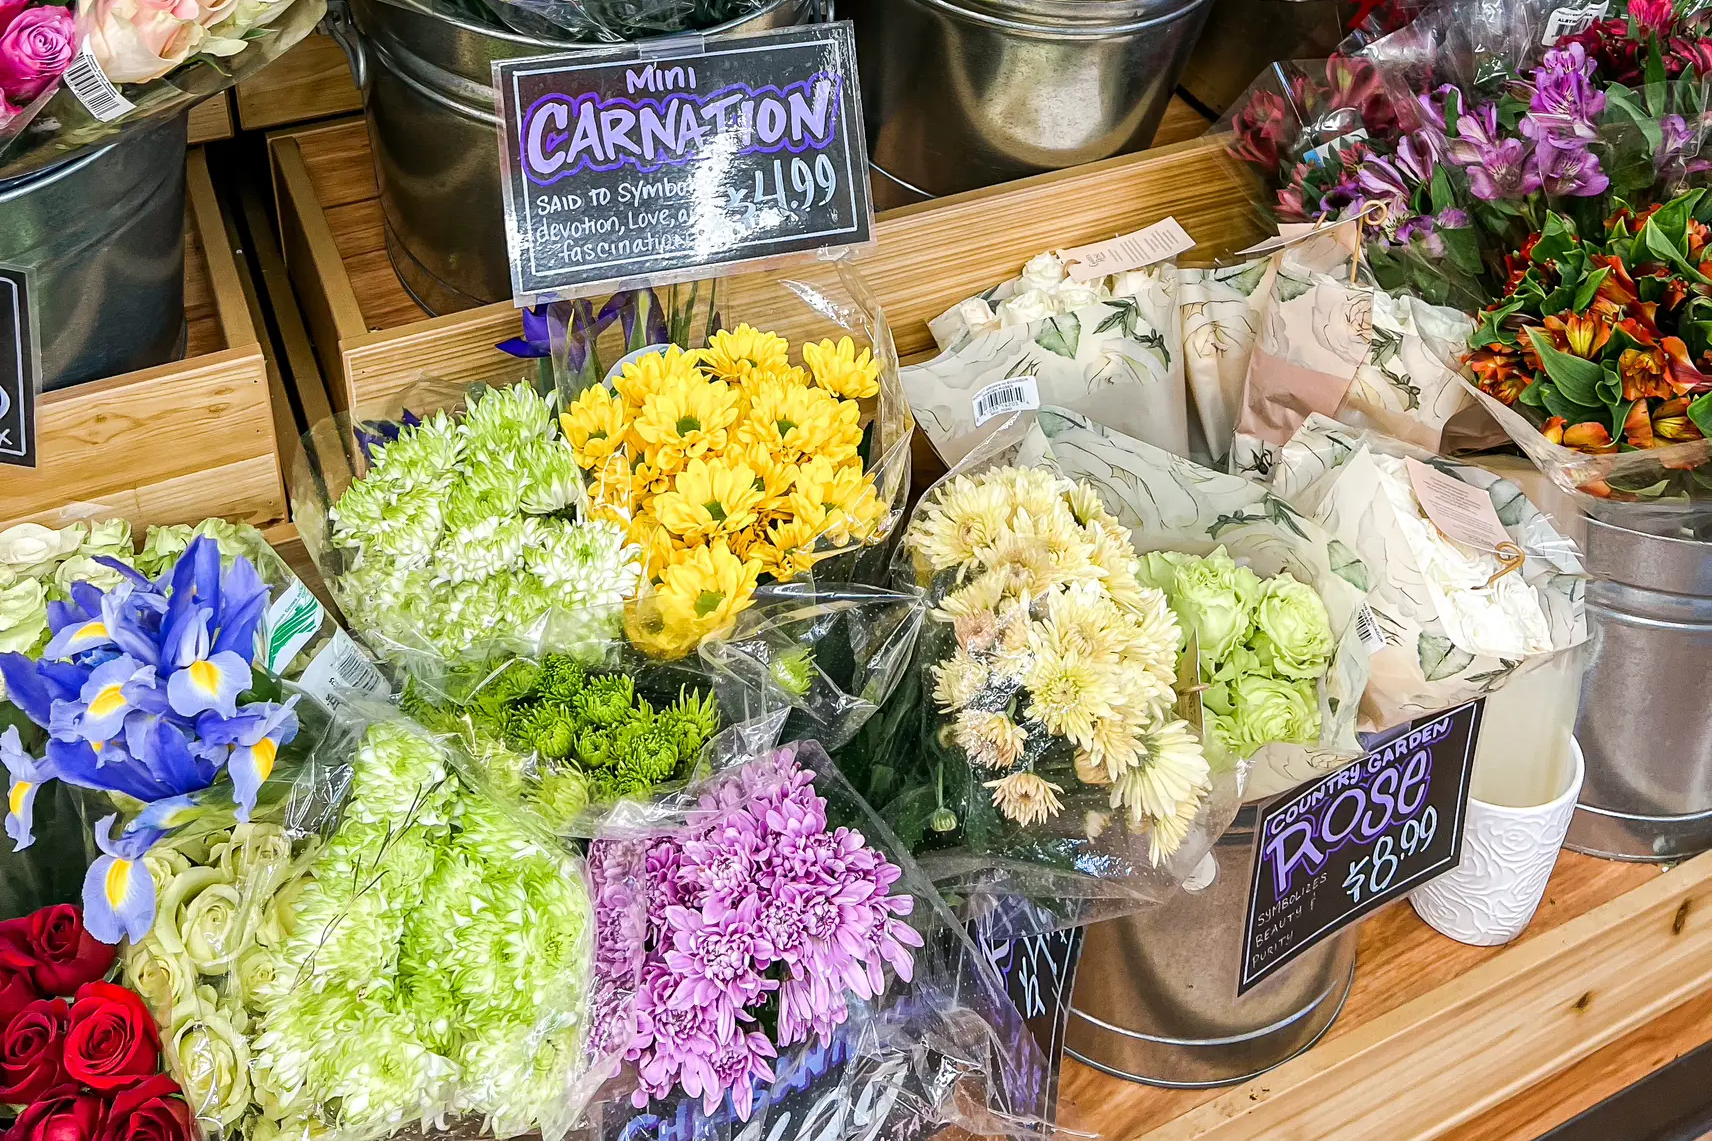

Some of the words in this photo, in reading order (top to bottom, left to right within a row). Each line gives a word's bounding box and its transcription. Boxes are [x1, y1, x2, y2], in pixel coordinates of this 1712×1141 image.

[626, 63, 697, 94] Mini
[528, 78, 832, 175] CARNATION
[537, 194, 583, 216] SAID
[589, 186, 612, 208] TO
[725, 153, 837, 227] $4.99
[536, 213, 625, 244] devotion,
[1270, 763, 1360, 836] COUNTRY
[1367, 717, 1449, 775] GARDEN
[1342, 806, 1438, 903] $8.99
[1257, 872, 1328, 926] SYMBOLIZES
[1252, 929, 1294, 968] PURITY
[1255, 905, 1302, 948] BEAUTY
